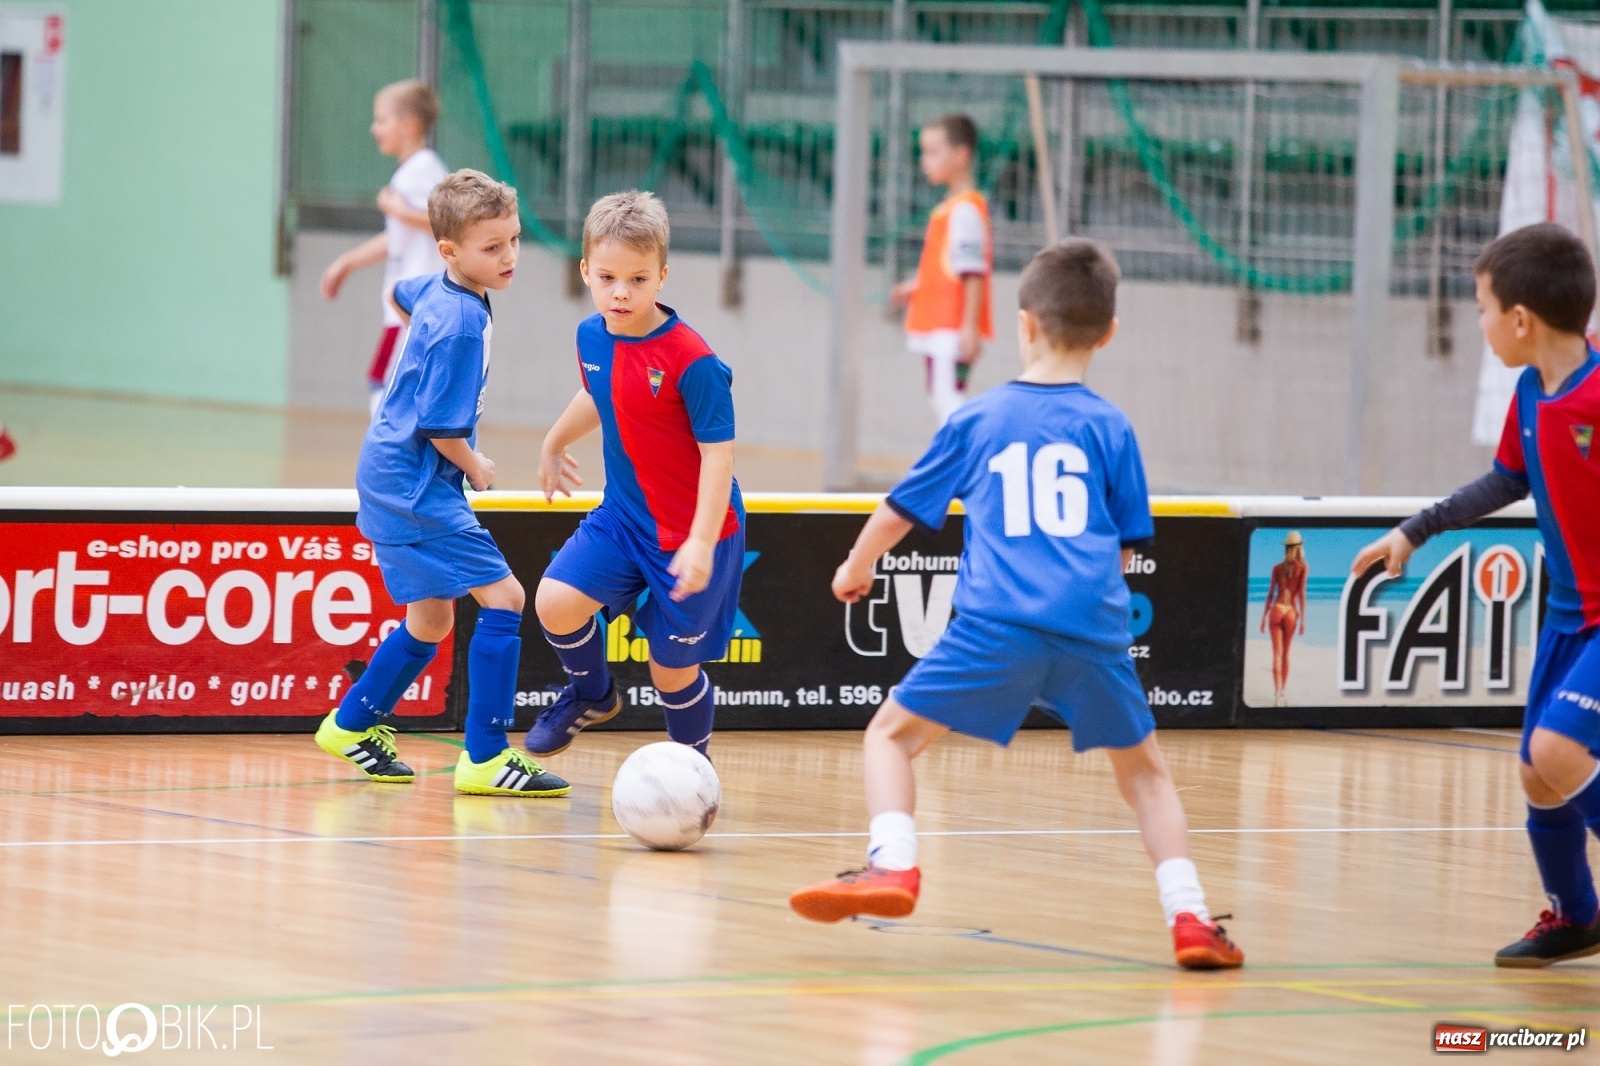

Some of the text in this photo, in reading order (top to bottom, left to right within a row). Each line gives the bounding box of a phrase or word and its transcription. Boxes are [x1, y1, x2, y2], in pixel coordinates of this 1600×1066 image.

[581, 362, 601, 371] regio
[987, 441, 1089, 538] 16
[87, 535, 201, 564] e-shop
[211, 541, 268, 565] pro
[278, 536, 342, 560] Váš
[110, 675, 196, 706] cyklo
[230, 675, 295, 706] golf
[796, 685, 833, 706] tel.
[839, 686, 883, 705] 596
